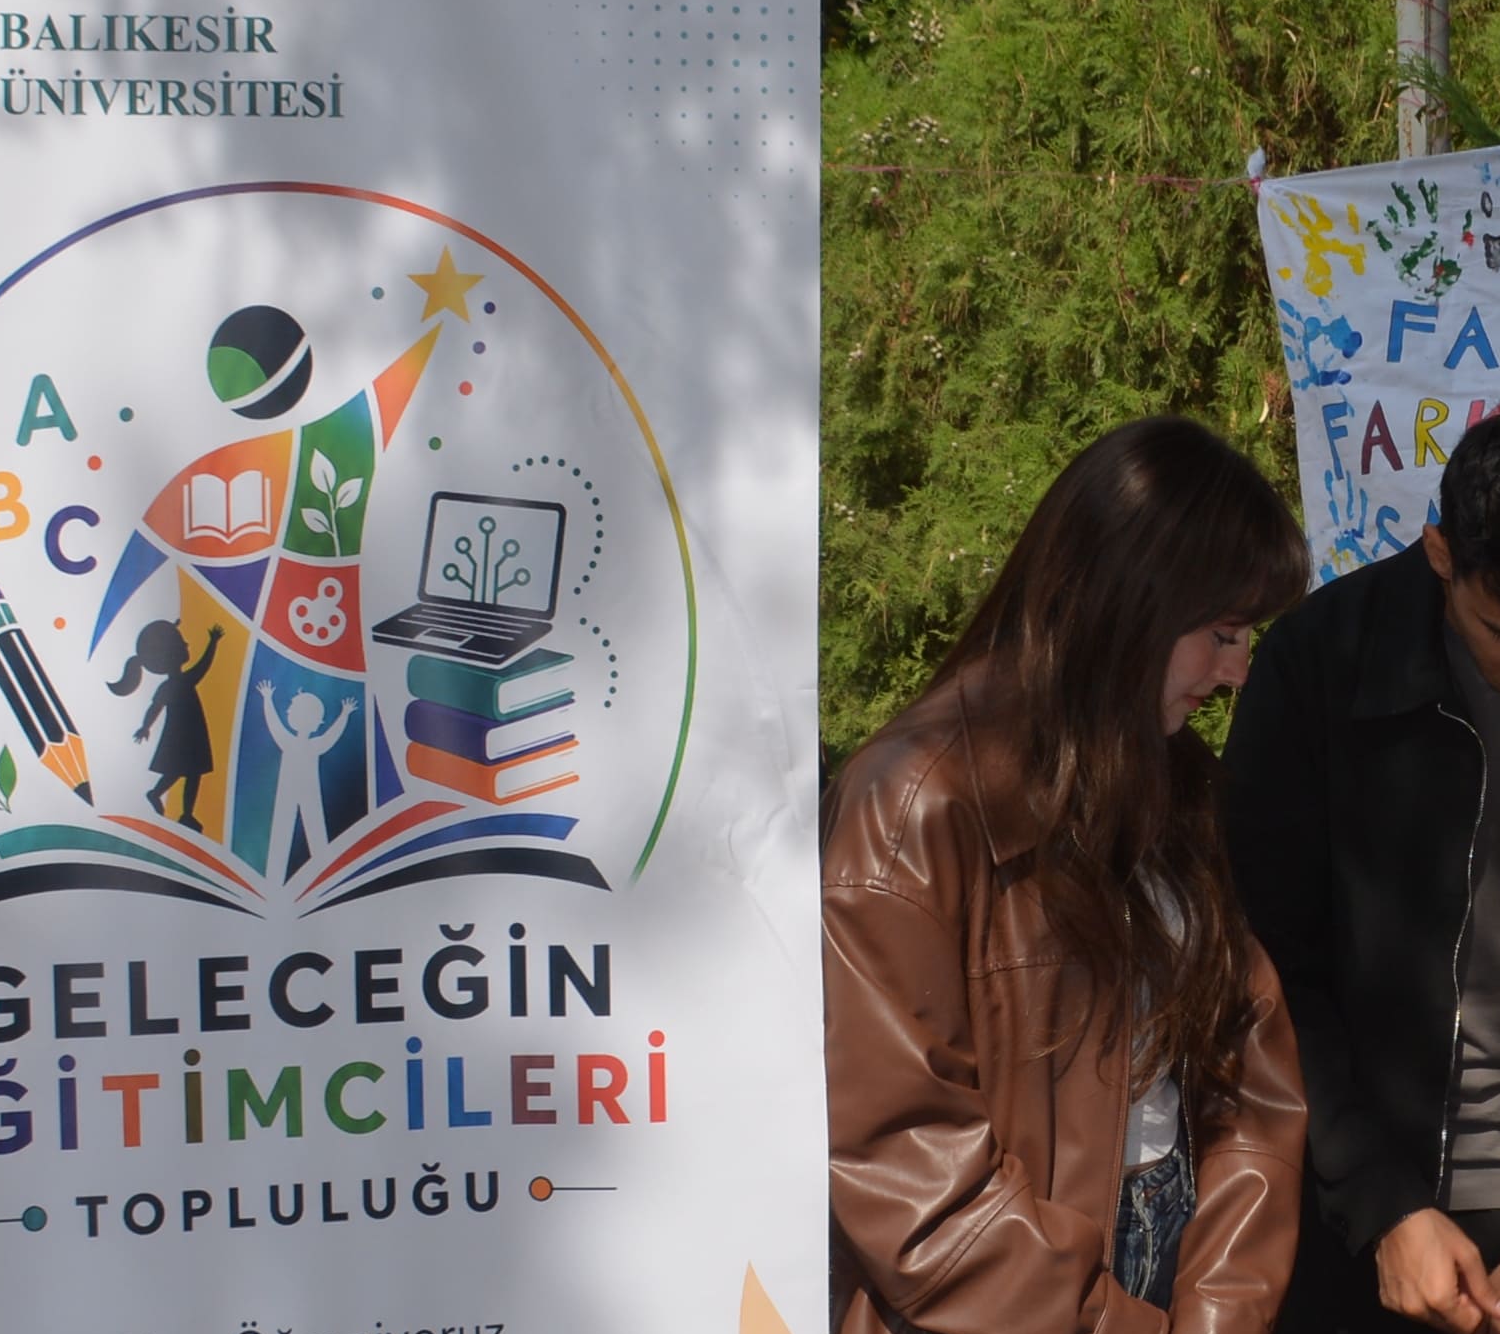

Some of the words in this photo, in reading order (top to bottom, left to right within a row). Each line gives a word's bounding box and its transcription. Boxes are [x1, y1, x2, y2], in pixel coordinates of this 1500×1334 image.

[0, 6, 276, 54] BALIKESİR
[0, 70, 344, 119] ÜNİVERSİTESİ
[15, 372, 78, 445] A
[44, 505, 99, 575] C
[77, 1162, 501, 1238] TOPLULUĞU
